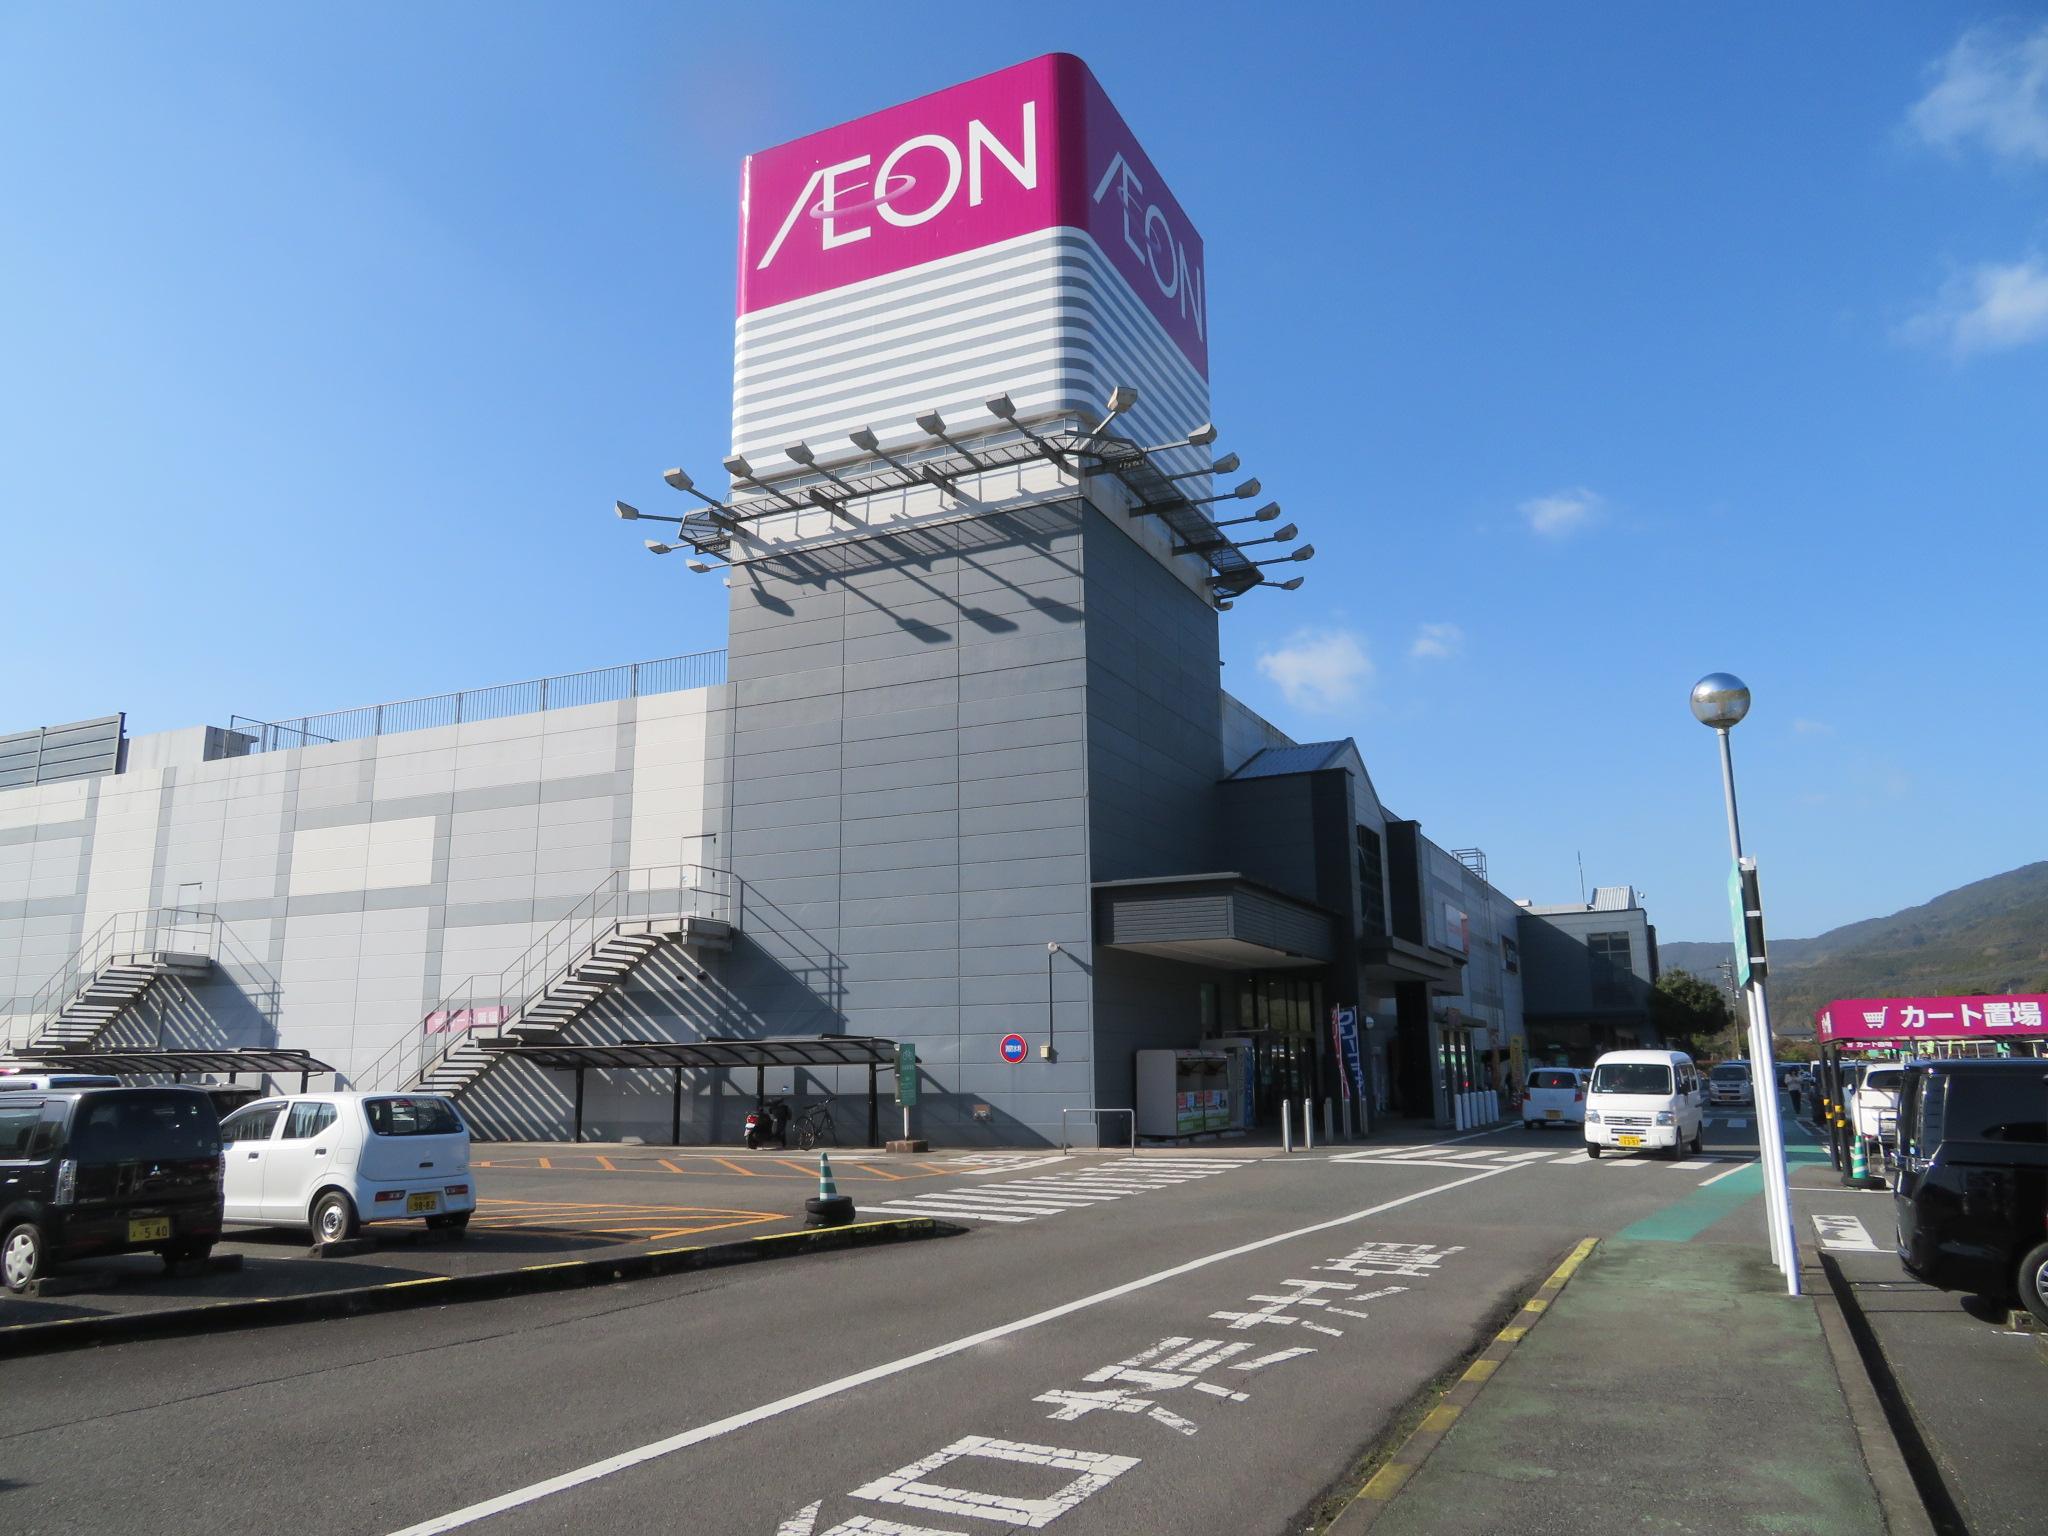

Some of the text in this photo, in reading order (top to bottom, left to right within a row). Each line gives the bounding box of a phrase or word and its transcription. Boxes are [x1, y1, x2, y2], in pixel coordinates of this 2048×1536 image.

[1900, 1001, 2042, 1028] カート置場
